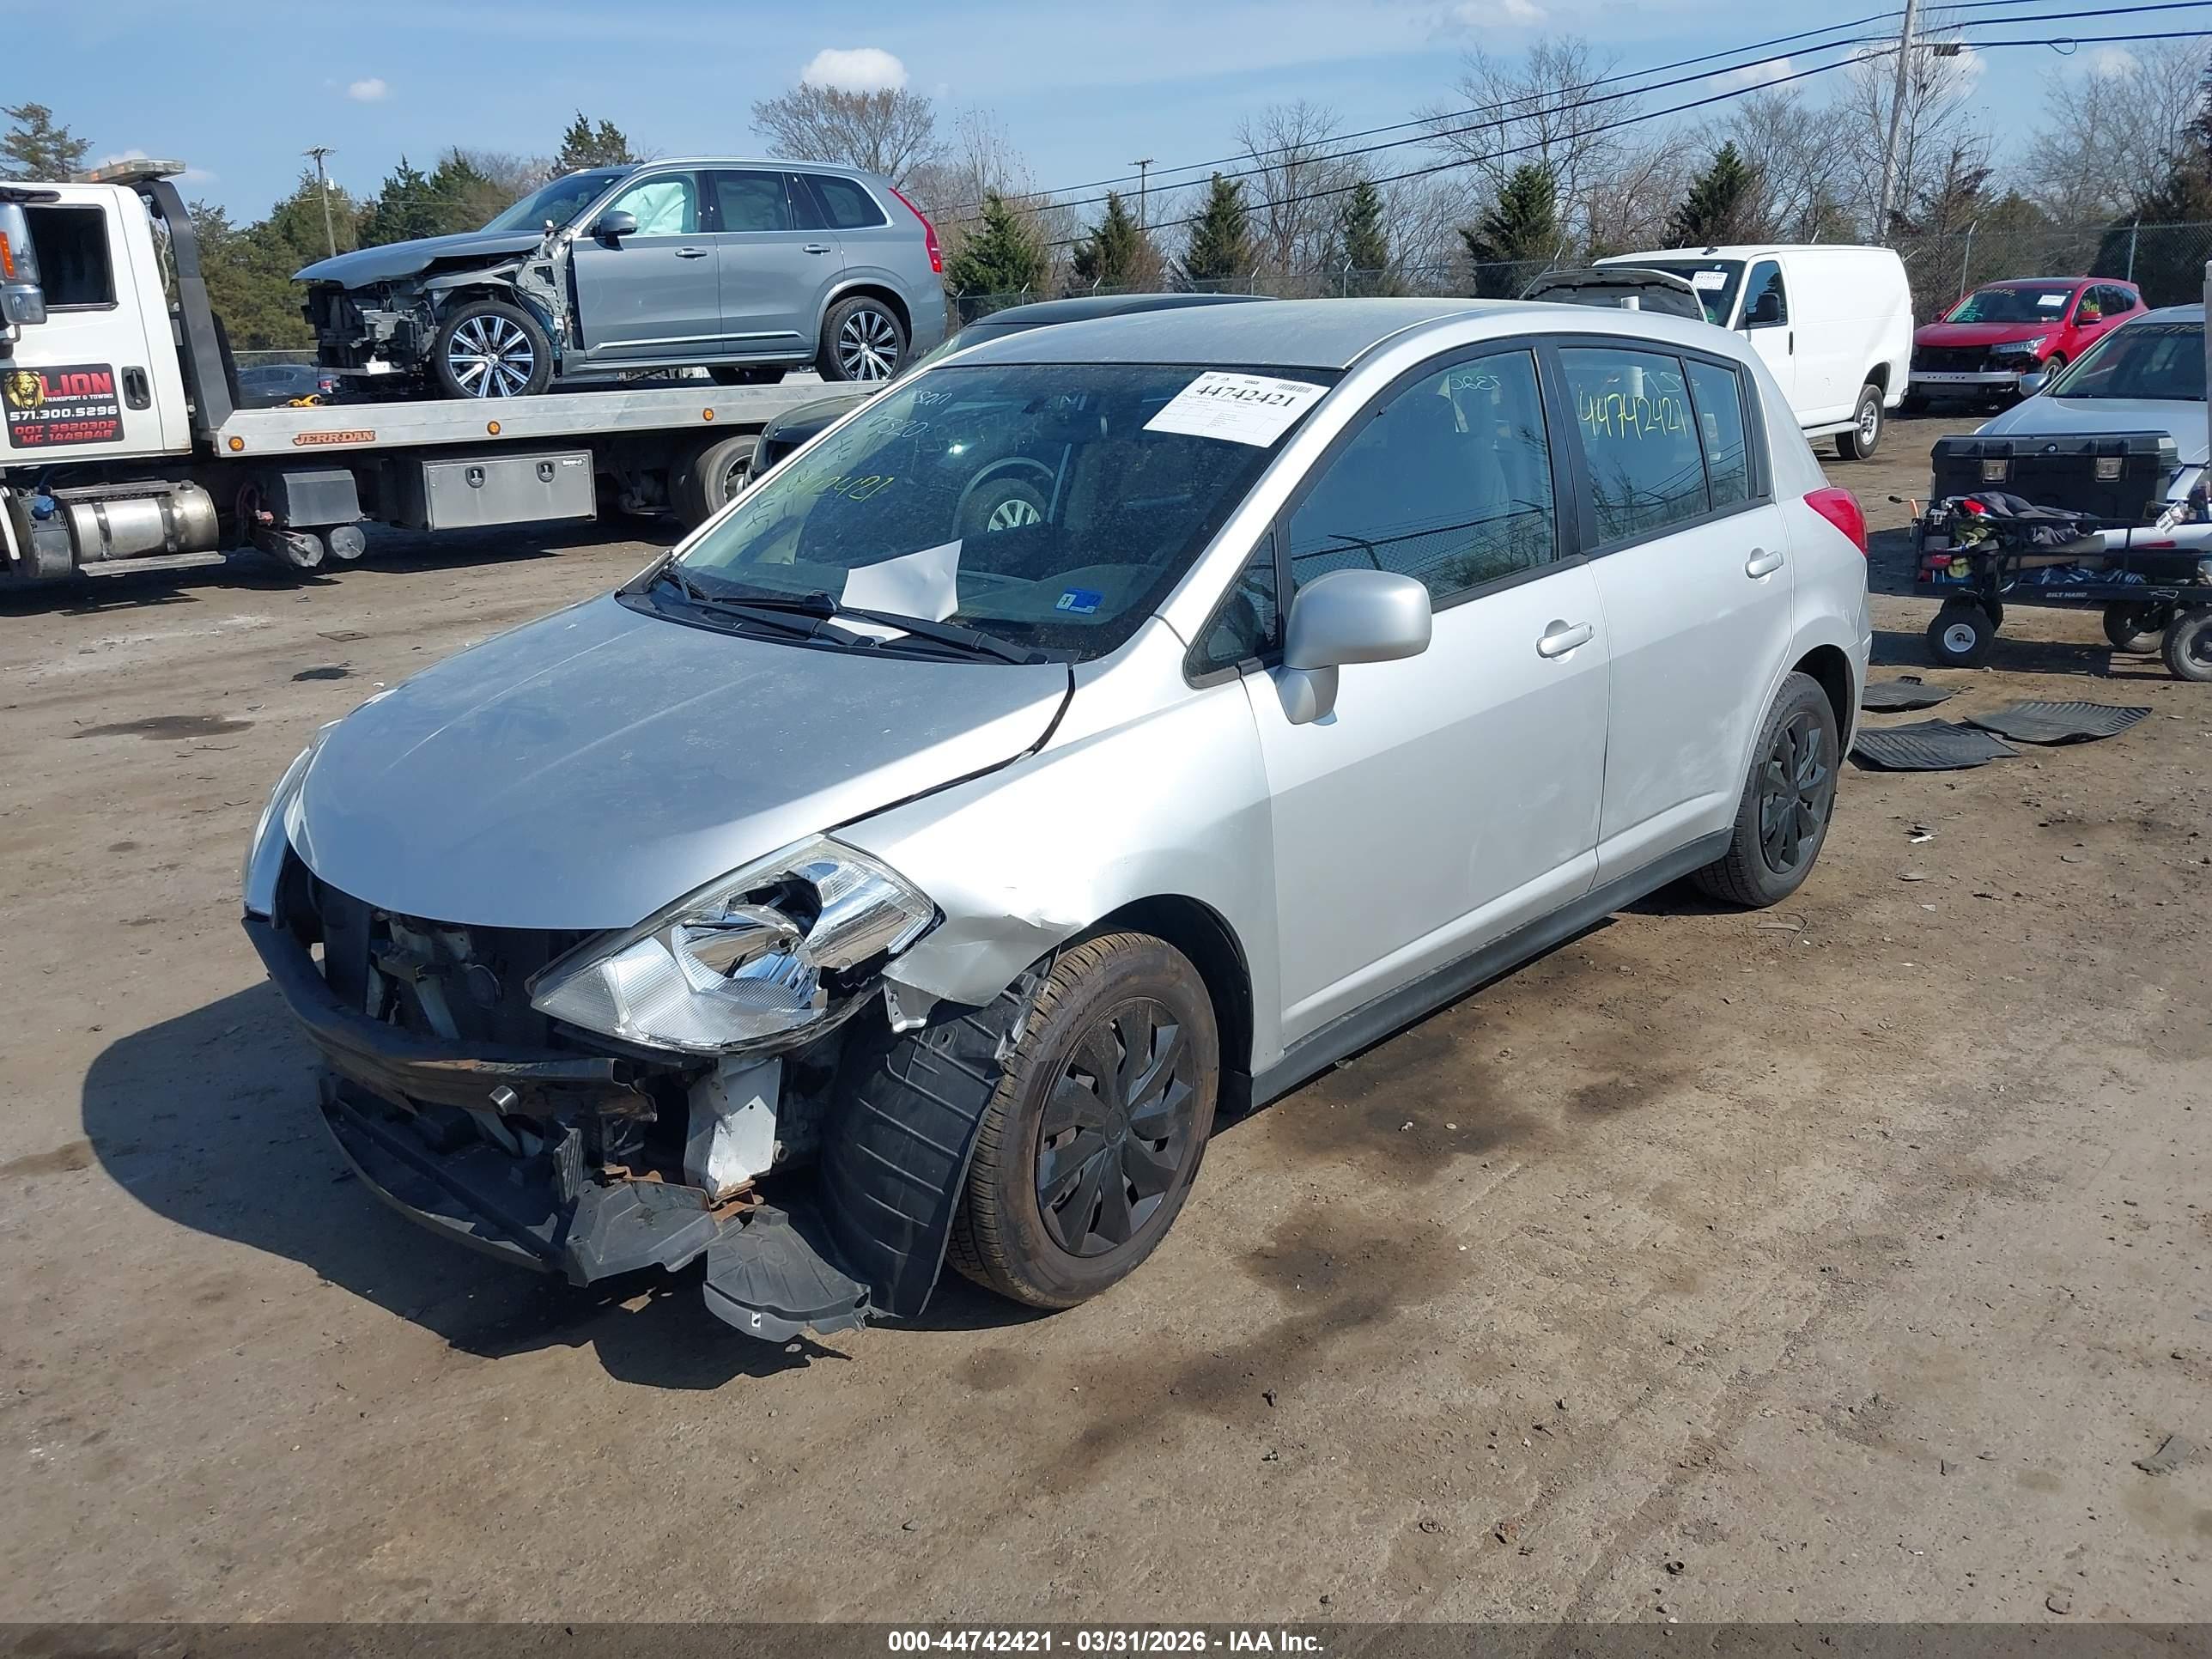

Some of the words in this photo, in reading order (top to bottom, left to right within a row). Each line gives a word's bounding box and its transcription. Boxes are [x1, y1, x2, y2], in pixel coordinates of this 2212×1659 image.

[40, 372, 112, 398] LION
[1196, 385, 1296, 407] 44742421
[9, 405, 118, 422] 571.300.5296
[1579, 390, 1687, 441] 44742421
[14, 425, 44, 435] DOT
[50, 420, 118, 433] 3920302
[22, 434, 43, 444] MC
